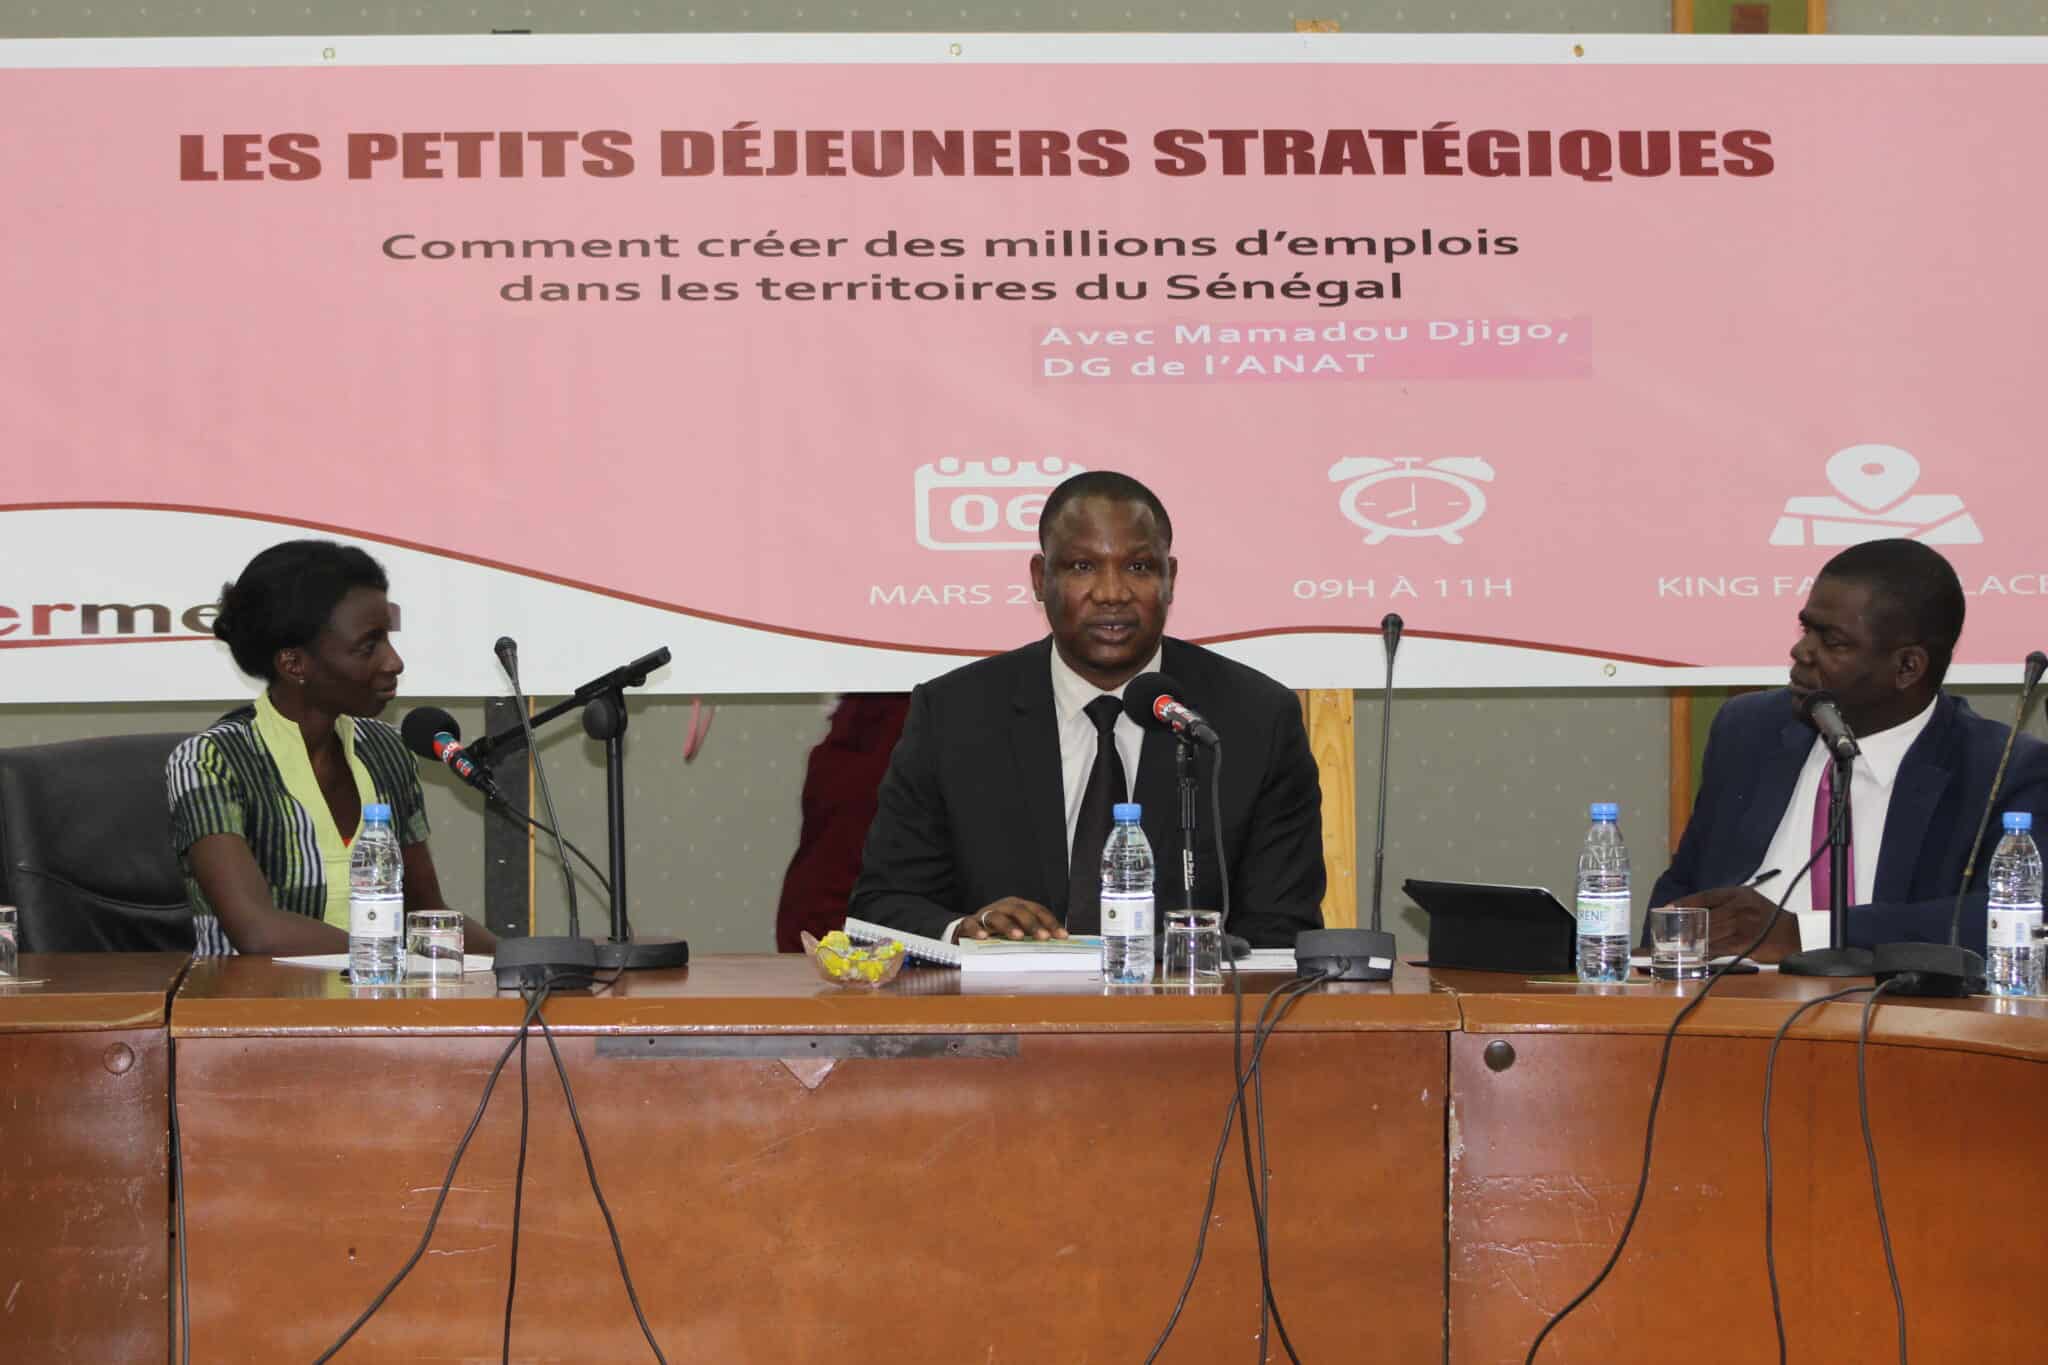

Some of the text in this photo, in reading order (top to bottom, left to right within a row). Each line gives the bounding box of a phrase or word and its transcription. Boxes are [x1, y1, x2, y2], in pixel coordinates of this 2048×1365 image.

[180, 121, 1776, 184] LES PETITS DÉJEUNERS STRATÉGIQUES
[382, 232, 681, 262] Comment
[698, 230, 850, 259] créer
[864, 230, 967, 259] des
[985, 229, 1218, 259] millions
[500, 272, 1403, 309] dans les territoires du Sénégal
[1041, 321, 1570, 348] Avec Mamadou Djigo,
[1043, 357, 1113, 378] DG
[1131, 356, 1186, 378] de
[951, 494, 1042, 533] 06
[869, 584, 993, 606] MARS
[1293, 575, 1514, 600] 09H À 11H
[1658, 576, 1761, 598] KING
